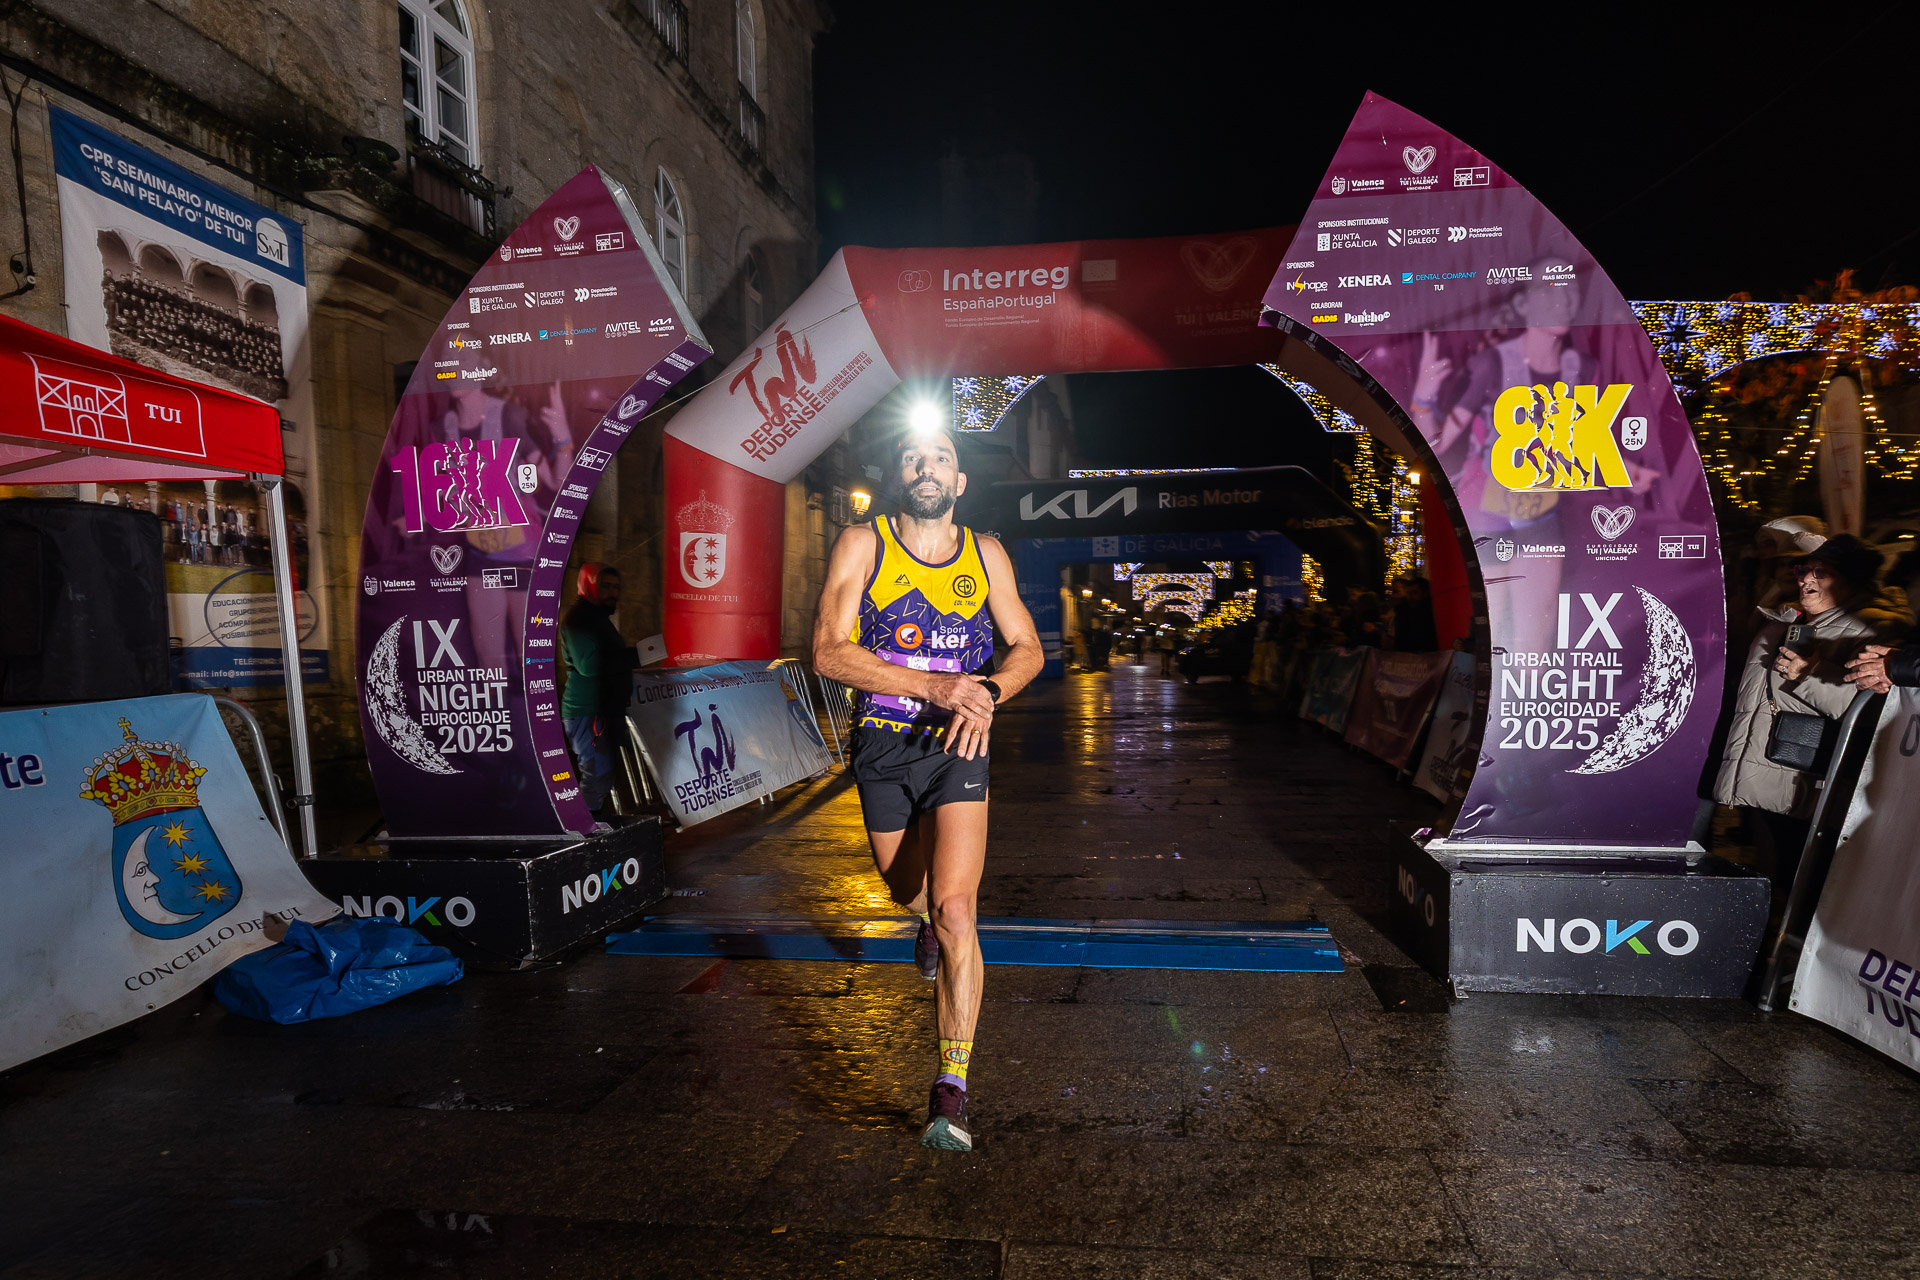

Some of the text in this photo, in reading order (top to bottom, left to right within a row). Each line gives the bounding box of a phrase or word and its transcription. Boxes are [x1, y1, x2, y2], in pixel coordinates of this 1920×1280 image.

[80, 144, 254, 232] CPR SEMINARIO MENOR
[1351, 179, 1385, 188] Valença
[1412, 178, 1439, 186] VALENÇA
[138, 186, 202, 223] PELAYO"
[205, 216, 222, 235] DE
[224, 224, 245, 245] TUI
[1318, 217, 1389, 229] SPONSORS INSTITUCIONAIS
[1407, 228, 1440, 236] DEPORTE
[1469, 225, 1503, 234] Deputación
[1469, 231, 1503, 239] Pontevedra
[1332, 233, 1361, 241] XUNTA
[1408, 237, 1437, 245] GALEGO
[1332, 239, 1378, 249] DE GALICIA
[516, 246, 542, 255] Valença
[1286, 261, 1315, 270] SPONSORS
[1545, 264, 1574, 273] KIA
[1416, 271, 1477, 281] DENTAL COMPANY
[1486, 266, 1533, 279] AVATEL
[943, 266, 1070, 292] Interreg
[1337, 274, 1392, 288] XENERA
[469, 286, 491, 294] SPONSORS
[540, 290, 565, 298] DEPORTE
[481, 296, 504, 305] XUNTA
[541, 298, 564, 306] GALEGO
[943, 291, 1056, 312] EspañaPortugal
[1310, 301, 1343, 310] COLABORAN
[481, 302, 518, 312] DE GALICIA
[1312, 314, 1339, 323] GADIS
[1344, 311, 1385, 324] Pancho
[447, 322, 470, 330] SPONSORS
[605, 321, 640, 333] AVATEL
[550, 327, 597, 338] DENTAL COMPANY
[489, 332, 532, 346] XENERA
[434, 360, 460, 368] COLABORAN
[857, 363, 866, 372] DE
[864, 357, 873, 367] TUI
[436, 371, 457, 380] GADIS
[144, 403, 182, 424] TUI
[740, 384, 815, 455] DEPORTE
[750, 396, 826, 463] TUDENSE
[1625, 438, 1643, 446] 25N
[1020, 486, 1262, 520] KIA Rias Motor
[1124, 537, 1224, 554] DE GALICIA
[1522, 544, 1566, 554] Valença
[1603, 547, 1638, 556] VALENÇA
[383, 580, 416, 588] Valença
[708, 594, 721, 602] DE
[722, 595, 739, 603] TUI
[1556, 592, 1624, 650] IX
[940, 626, 966, 636] Sport
[413, 618, 465, 669] IX
[529, 639, 553, 647] XENERA
[931, 630, 969, 649] ker
[1502, 652, 1623, 667] URBAN TRAIL
[417, 667, 508, 683] URBAN TRAIL
[1500, 669, 1623, 700] NIGHT
[419, 681, 508, 712] NIGHT
[1500, 701, 1621, 717] EUROCIDADE
[421, 710, 511, 726] EUROCIDADE
[439, 724, 513, 754] 2025
[1499, 719, 1599, 750] 2025
[552, 771, 571, 781] GADIS
[674, 768, 731, 800] DEPORTE
[681, 783, 736, 815] TUDENSE
[561, 857, 640, 915] NOKO
[1398, 863, 1435, 927] NOKO
[342, 895, 476, 927] NOKO
[1516, 917, 1700, 956] NOKO
[124, 926, 235, 992] CONCELLO
[238, 918, 265, 934] DE
